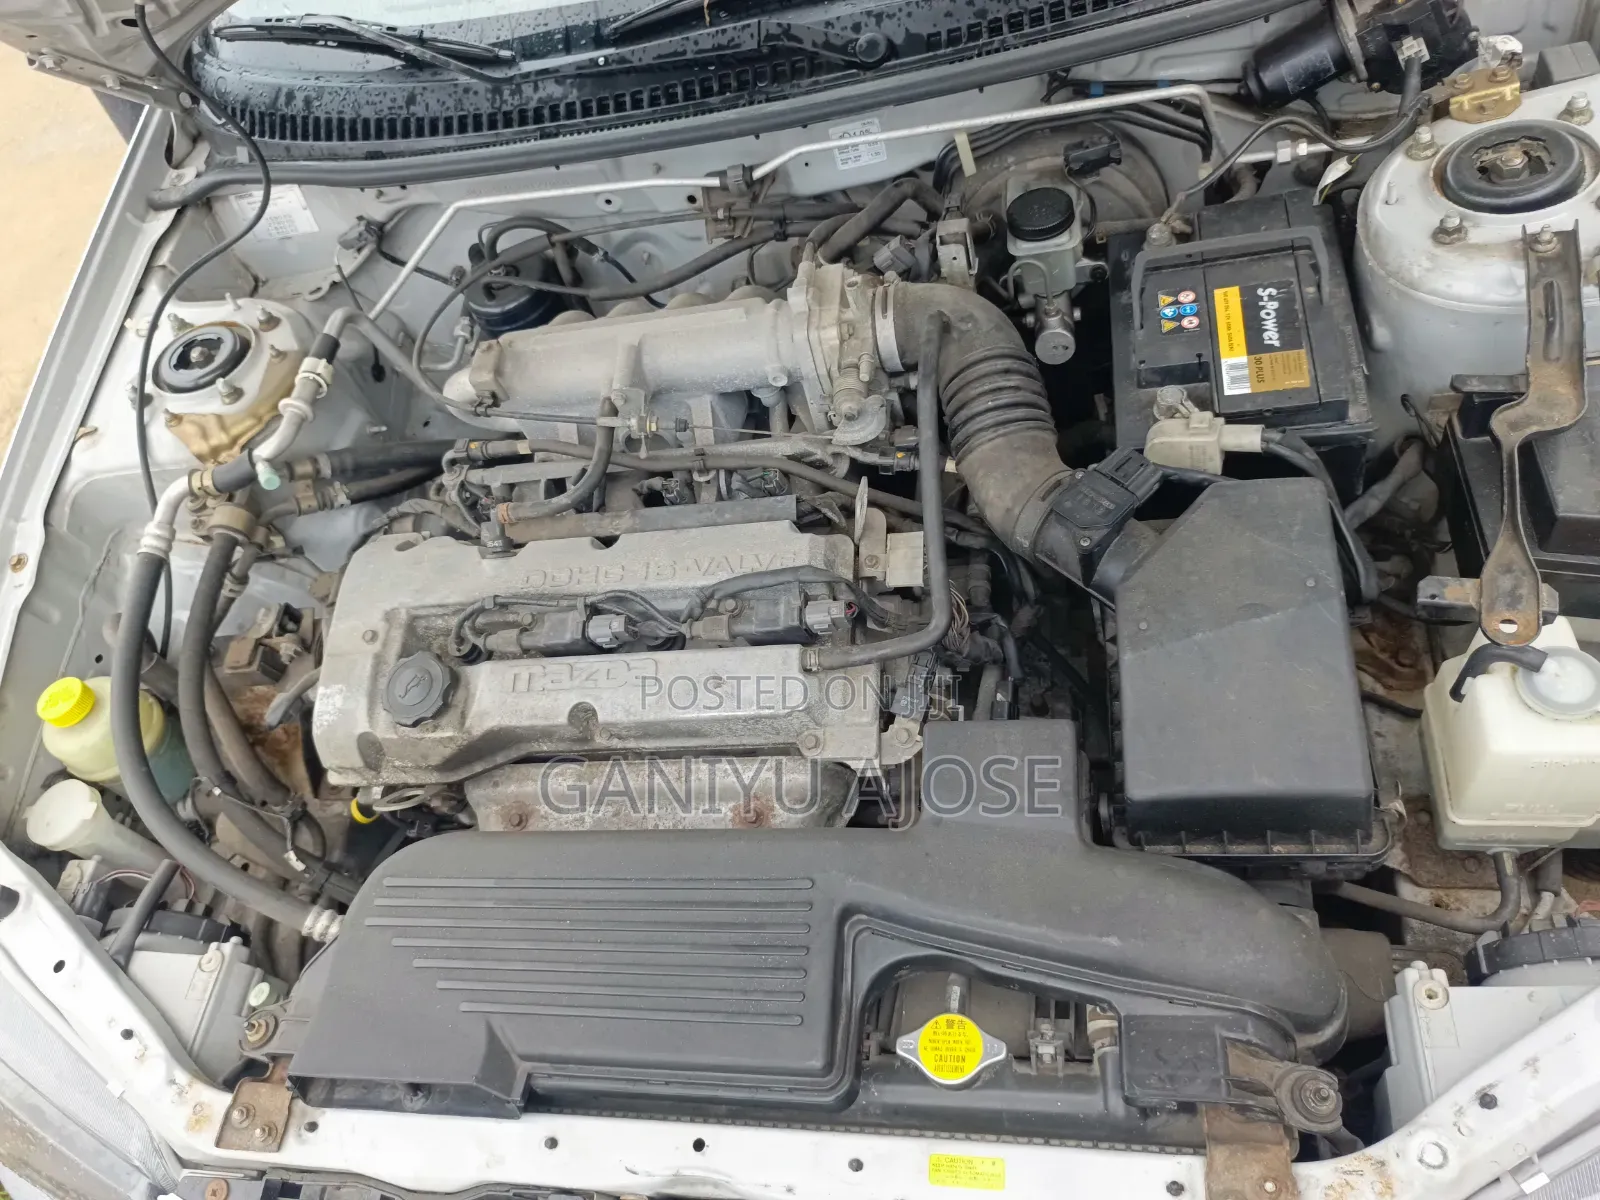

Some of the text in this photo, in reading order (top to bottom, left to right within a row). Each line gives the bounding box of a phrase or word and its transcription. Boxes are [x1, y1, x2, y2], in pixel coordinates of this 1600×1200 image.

[1257, 287, 1280, 347] S-Power
[1254, 356, 1266, 384] 30 PLUS
[508, 657, 658, 693] mazda
[934, 1054, 966, 1063] CAUTION
